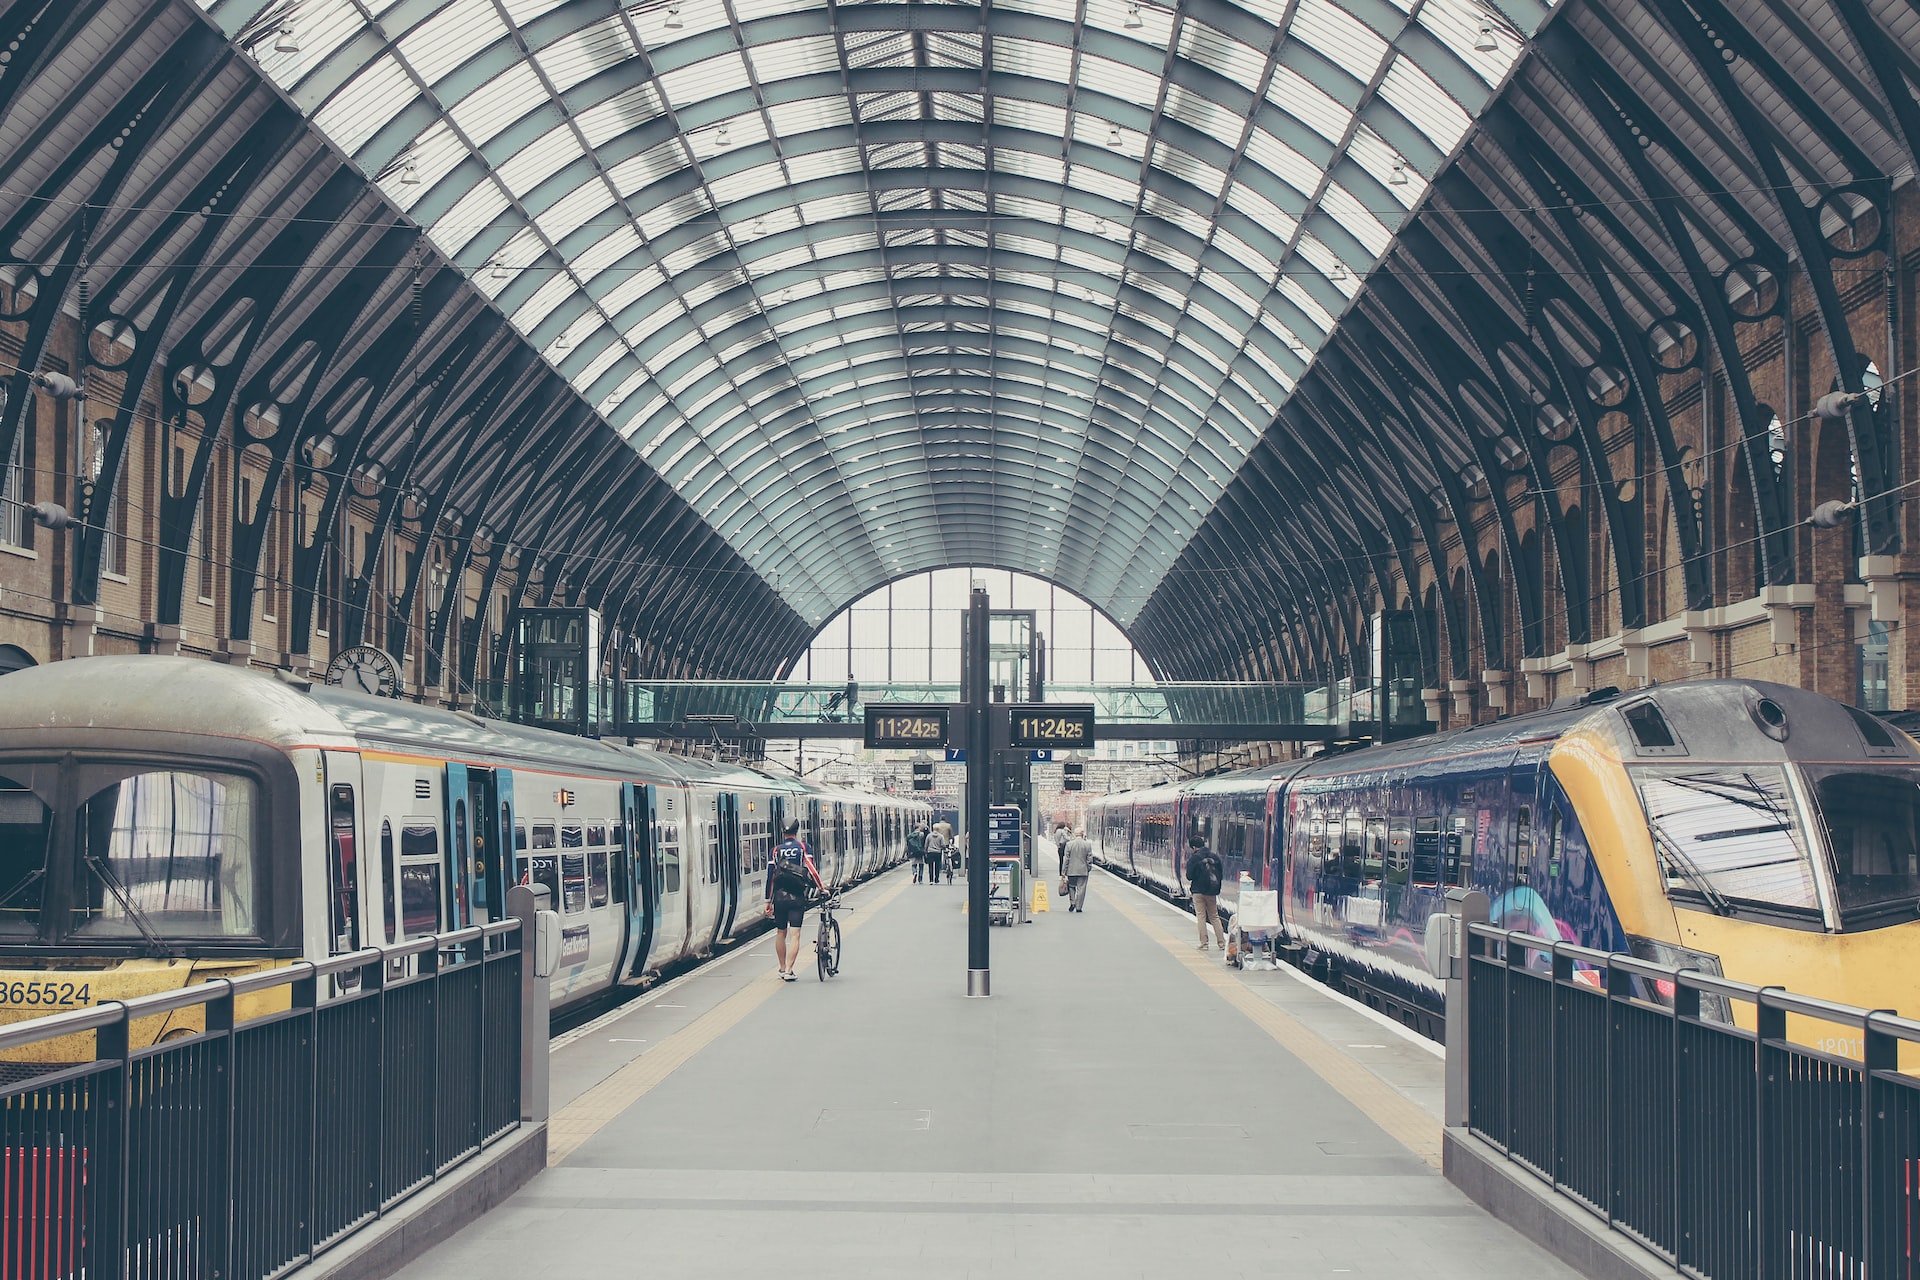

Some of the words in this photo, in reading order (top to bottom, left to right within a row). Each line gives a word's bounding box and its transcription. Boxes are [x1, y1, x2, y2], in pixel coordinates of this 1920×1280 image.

[951, 748, 959, 759] 7
[1037, 749, 1045, 759] 6
[780, 847, 799, 857] TCC
